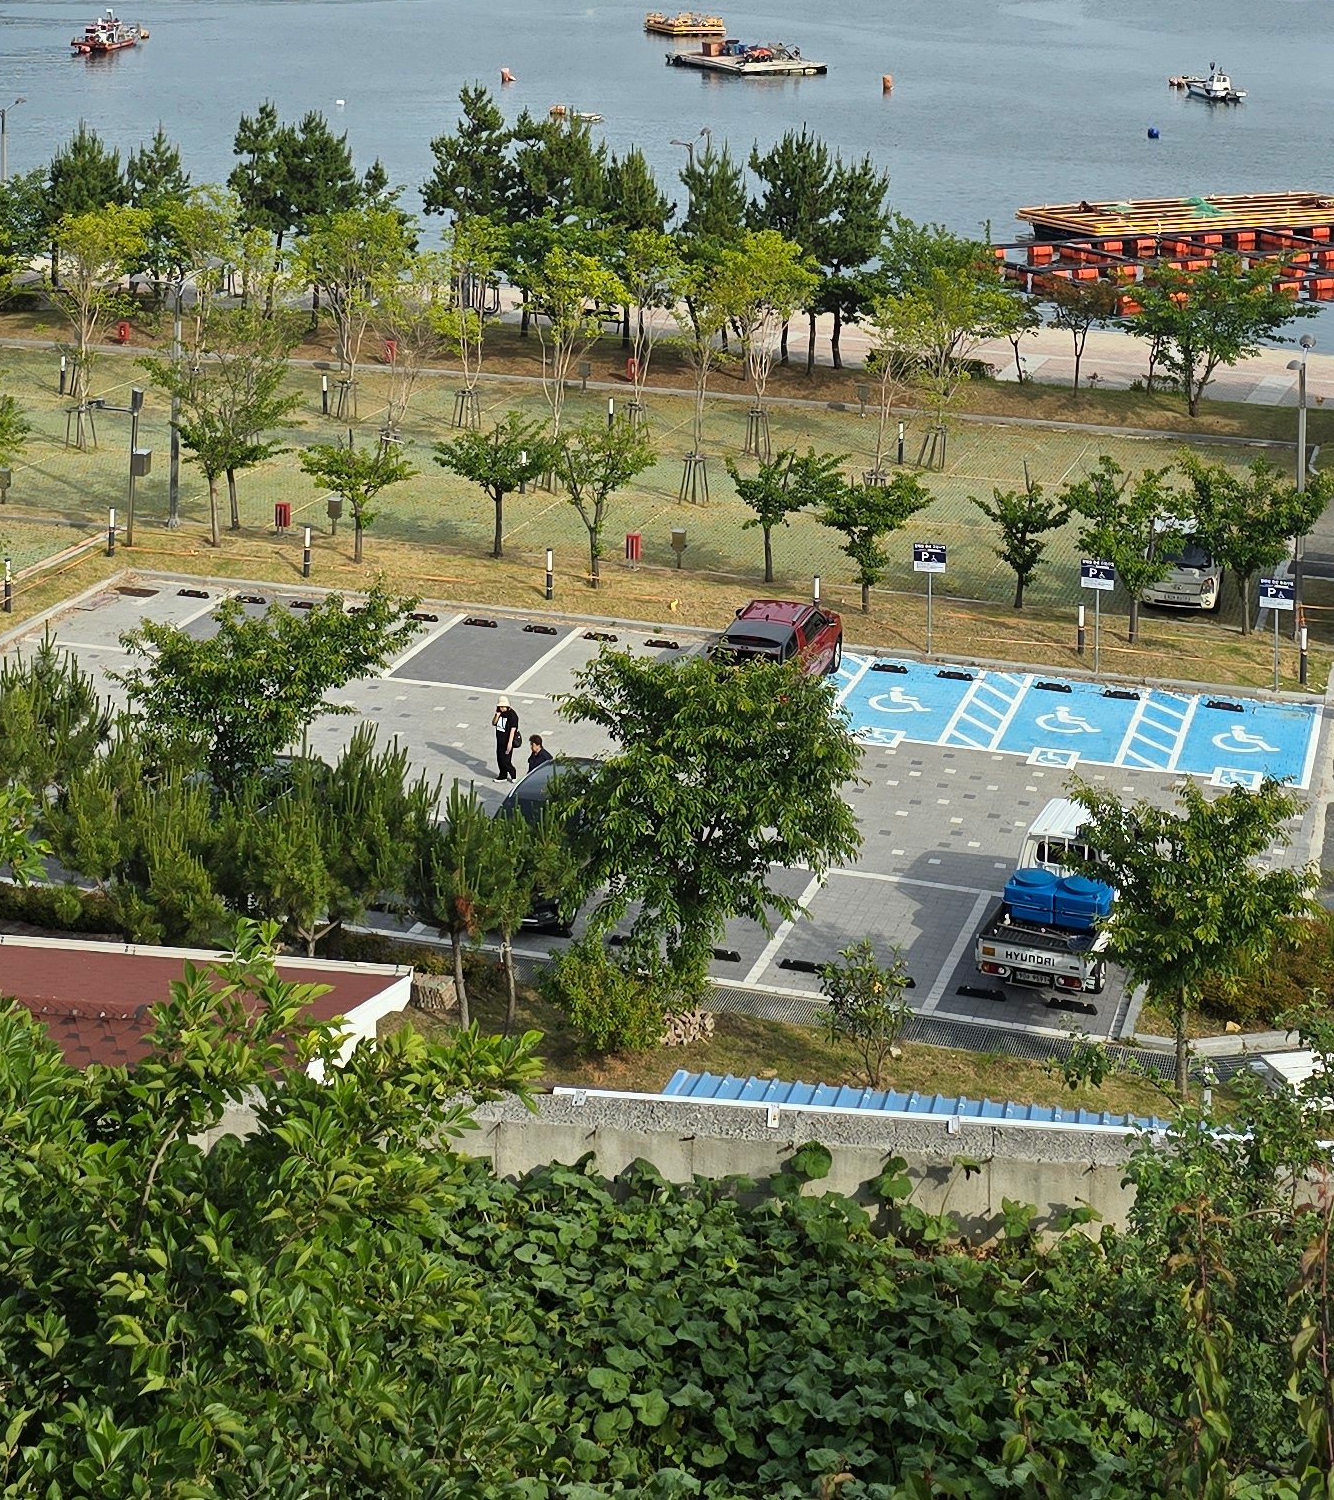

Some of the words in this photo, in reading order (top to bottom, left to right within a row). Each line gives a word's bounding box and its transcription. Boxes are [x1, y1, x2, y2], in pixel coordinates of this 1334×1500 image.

[921, 551, 930, 562] P
[1089, 567, 1098, 578] P
[1267, 587, 1277, 598] P
[1005, 950, 1055, 967] HYUNDAI
